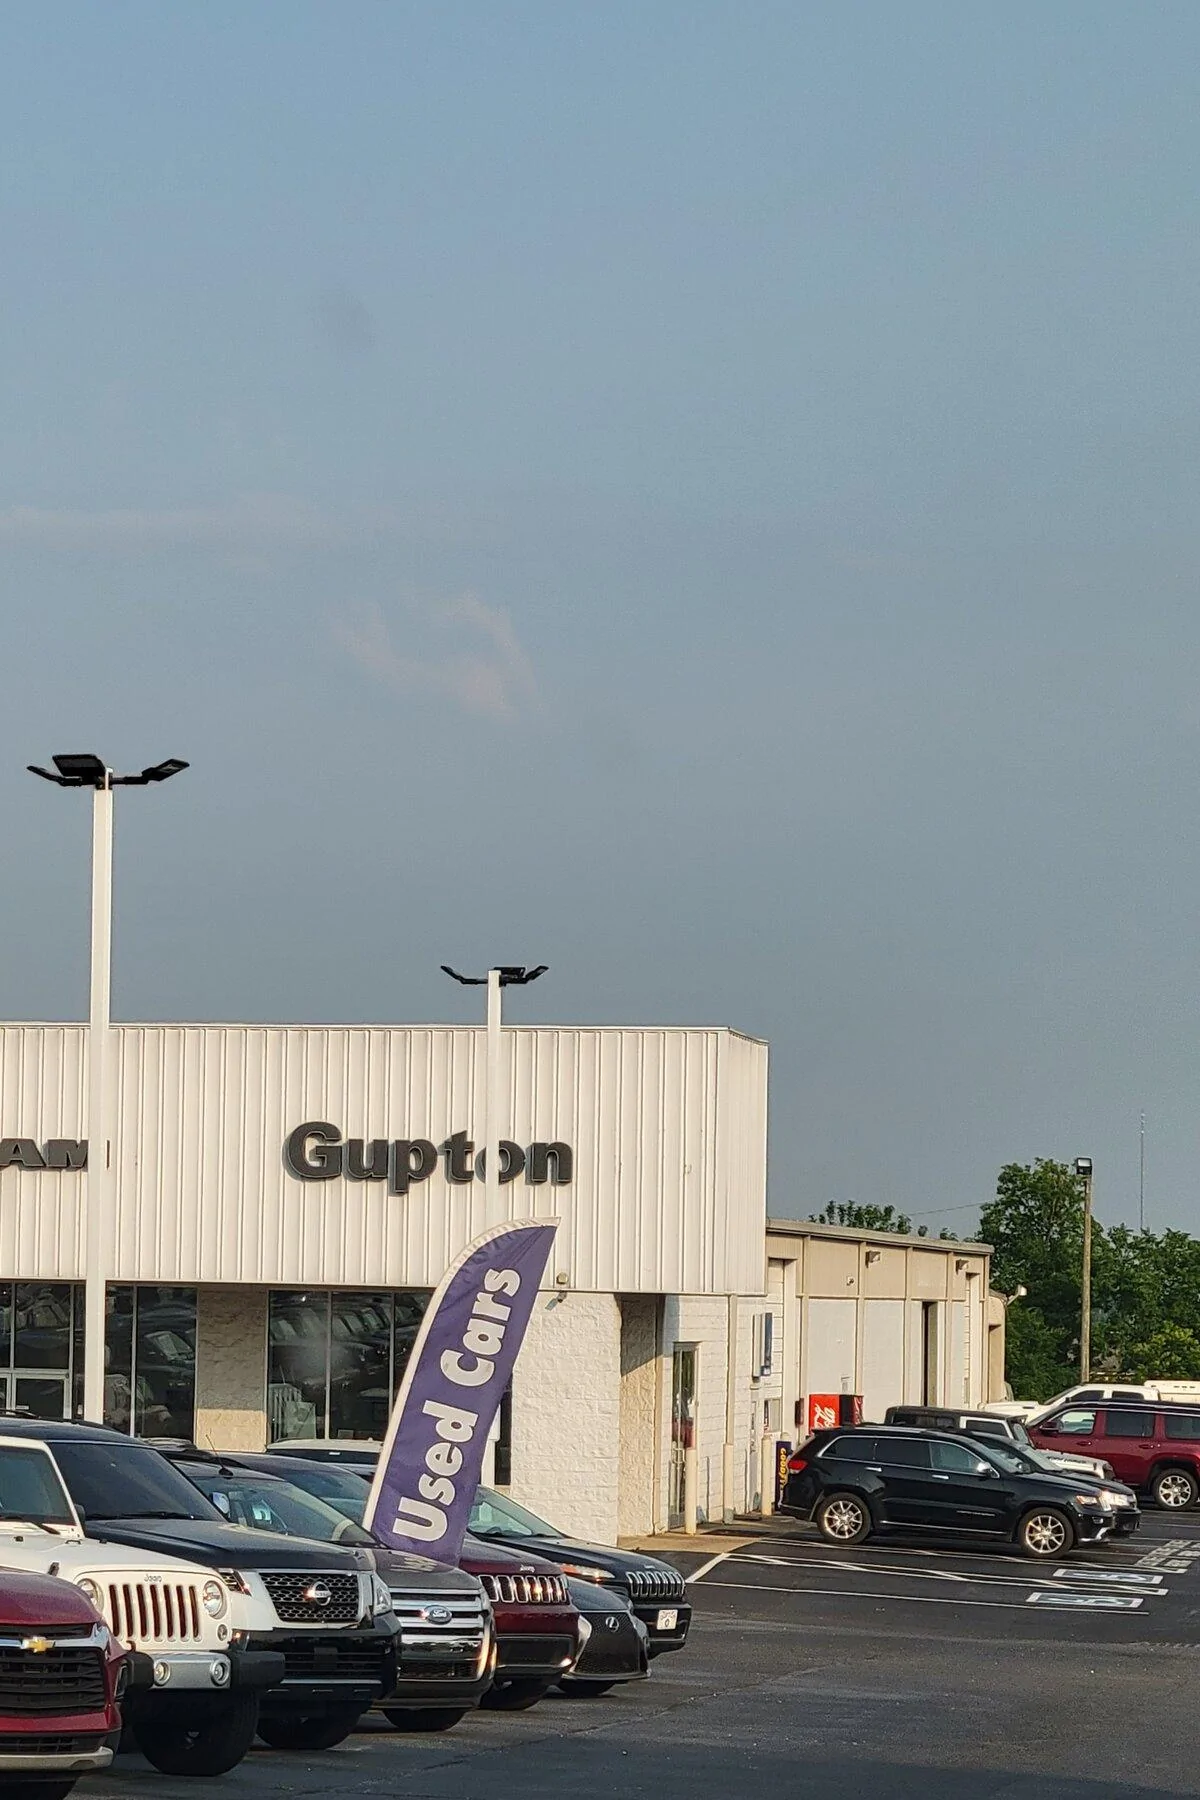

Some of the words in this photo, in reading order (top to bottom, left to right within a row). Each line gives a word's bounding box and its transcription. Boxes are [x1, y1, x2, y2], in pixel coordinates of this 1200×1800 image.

[287, 1121, 573, 1194] Gupton
[392, 1400, 479, 1542] Used
[440, 1268, 521, 1387] Cars
